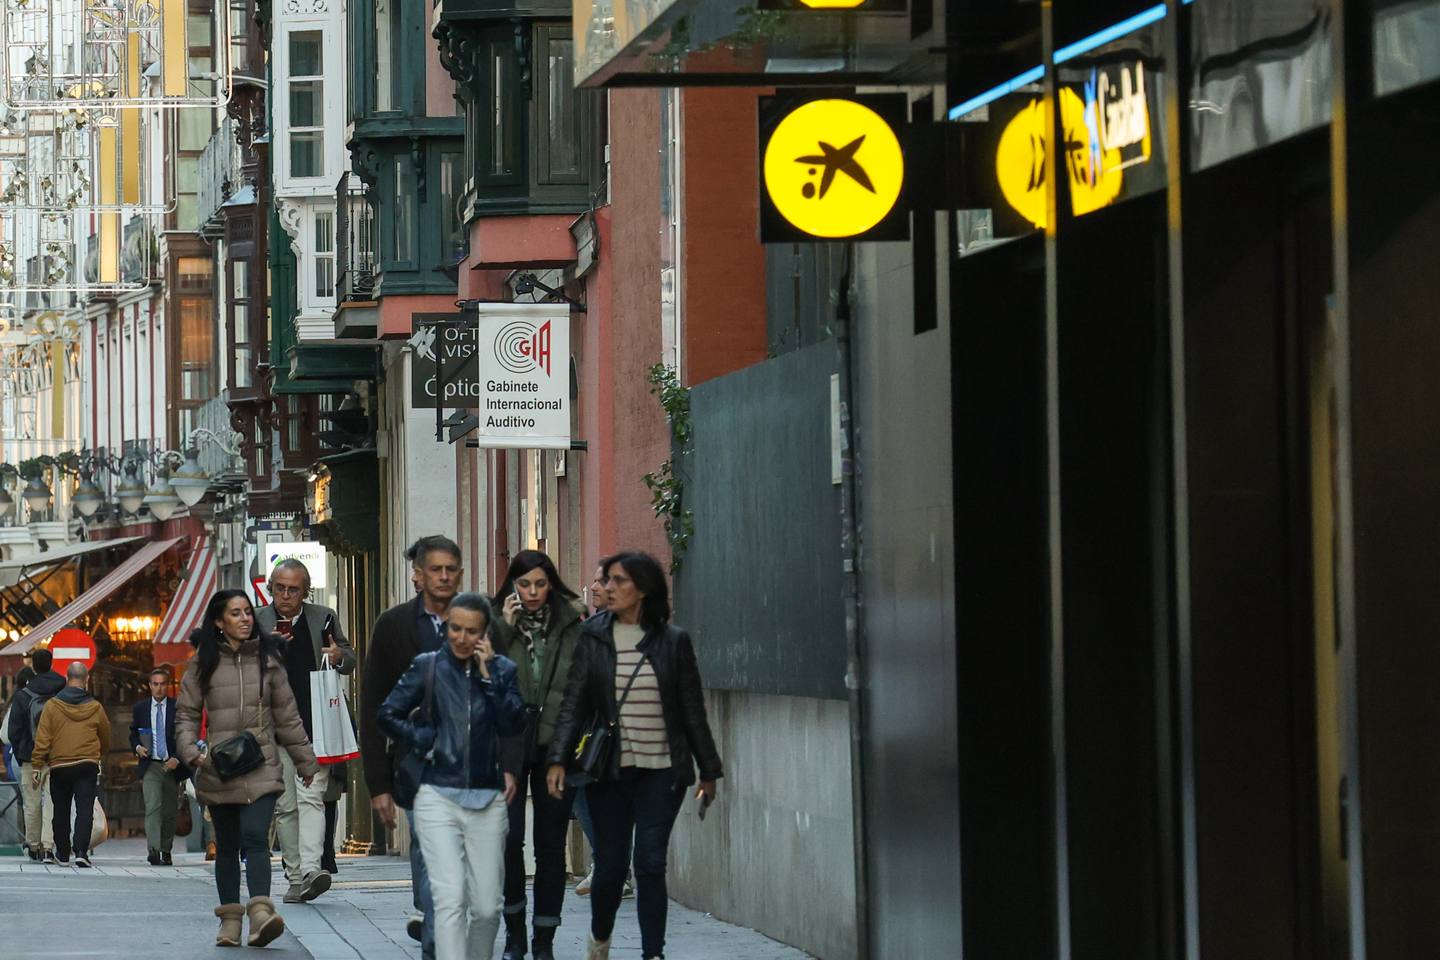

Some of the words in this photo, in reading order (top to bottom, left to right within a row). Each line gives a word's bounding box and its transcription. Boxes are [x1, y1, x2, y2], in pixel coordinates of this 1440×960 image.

[519, 319, 551, 378] GIA
[486, 380, 539, 392] Gabinete
[486, 398, 562, 410] Internacional
[486, 415, 535, 428] Auditivo
